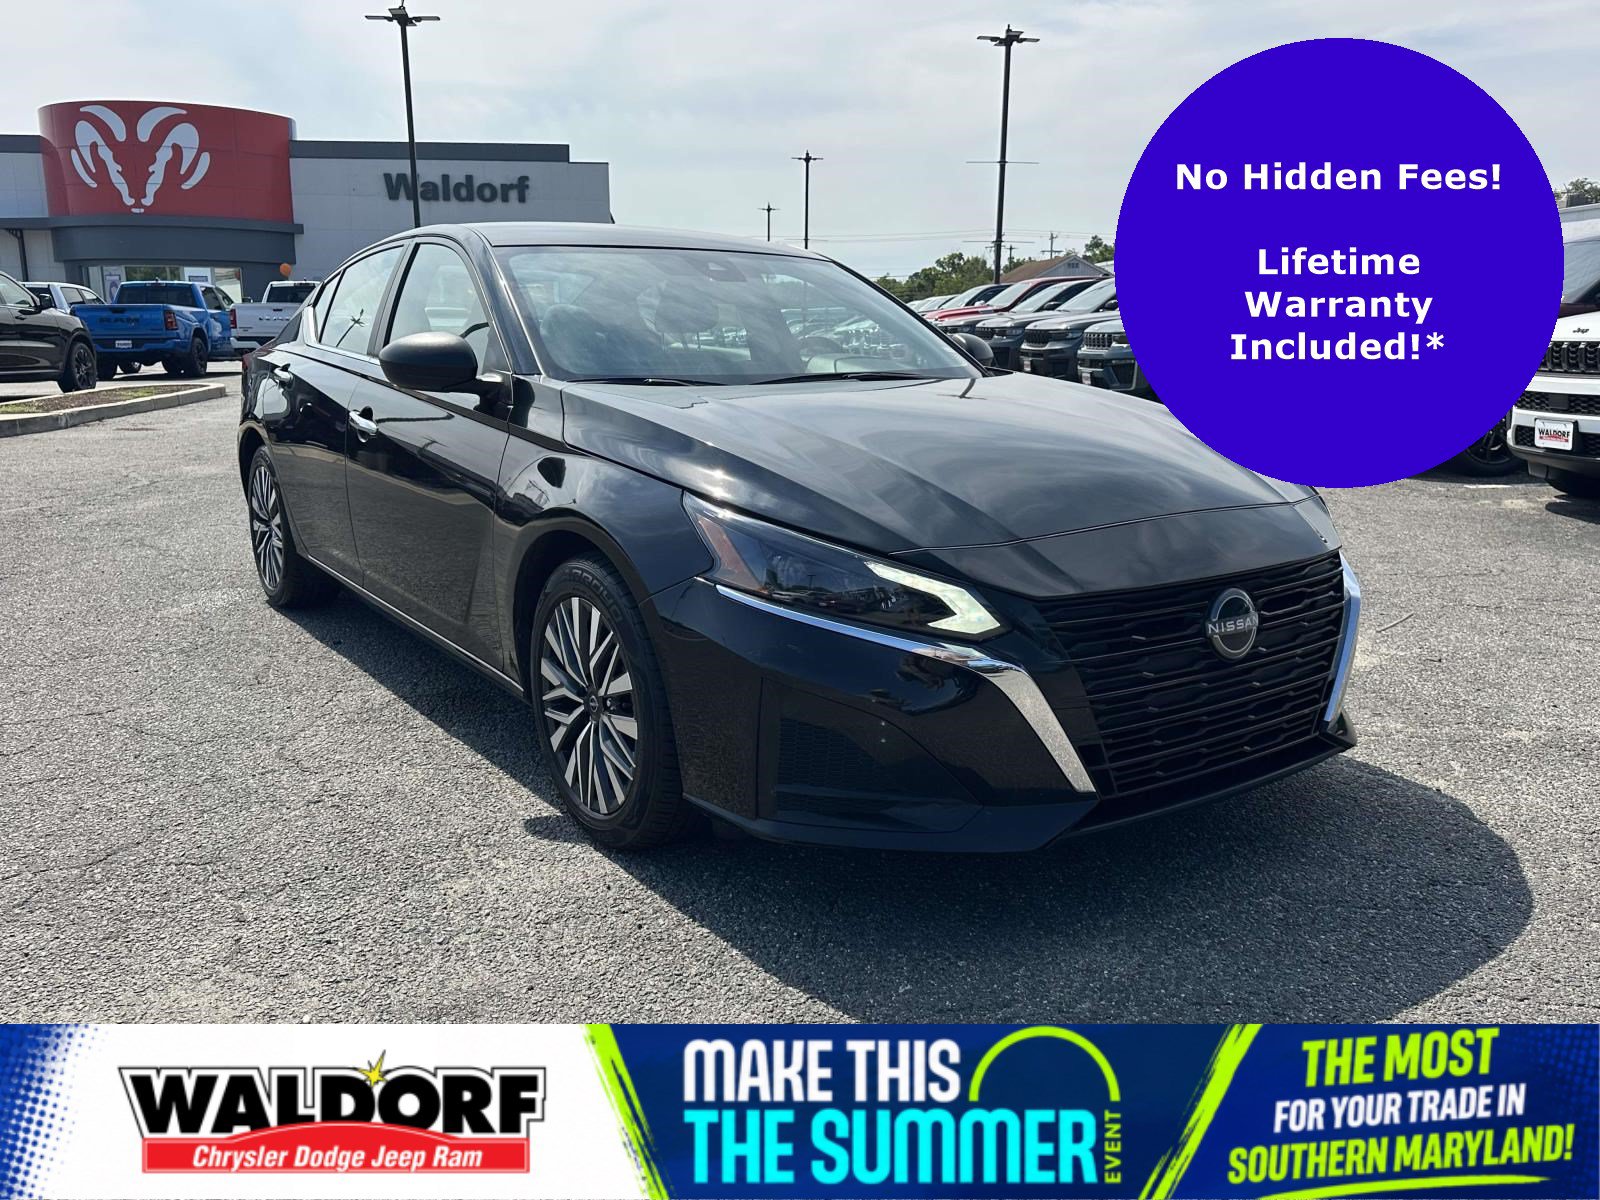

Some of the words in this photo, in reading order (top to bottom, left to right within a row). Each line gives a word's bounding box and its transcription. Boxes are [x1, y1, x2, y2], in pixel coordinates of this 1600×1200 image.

[383, 172, 530, 203] Waldorf
[1538, 427, 1571, 438] WALDORF
[1208, 614, 1258, 634] NISSAN
